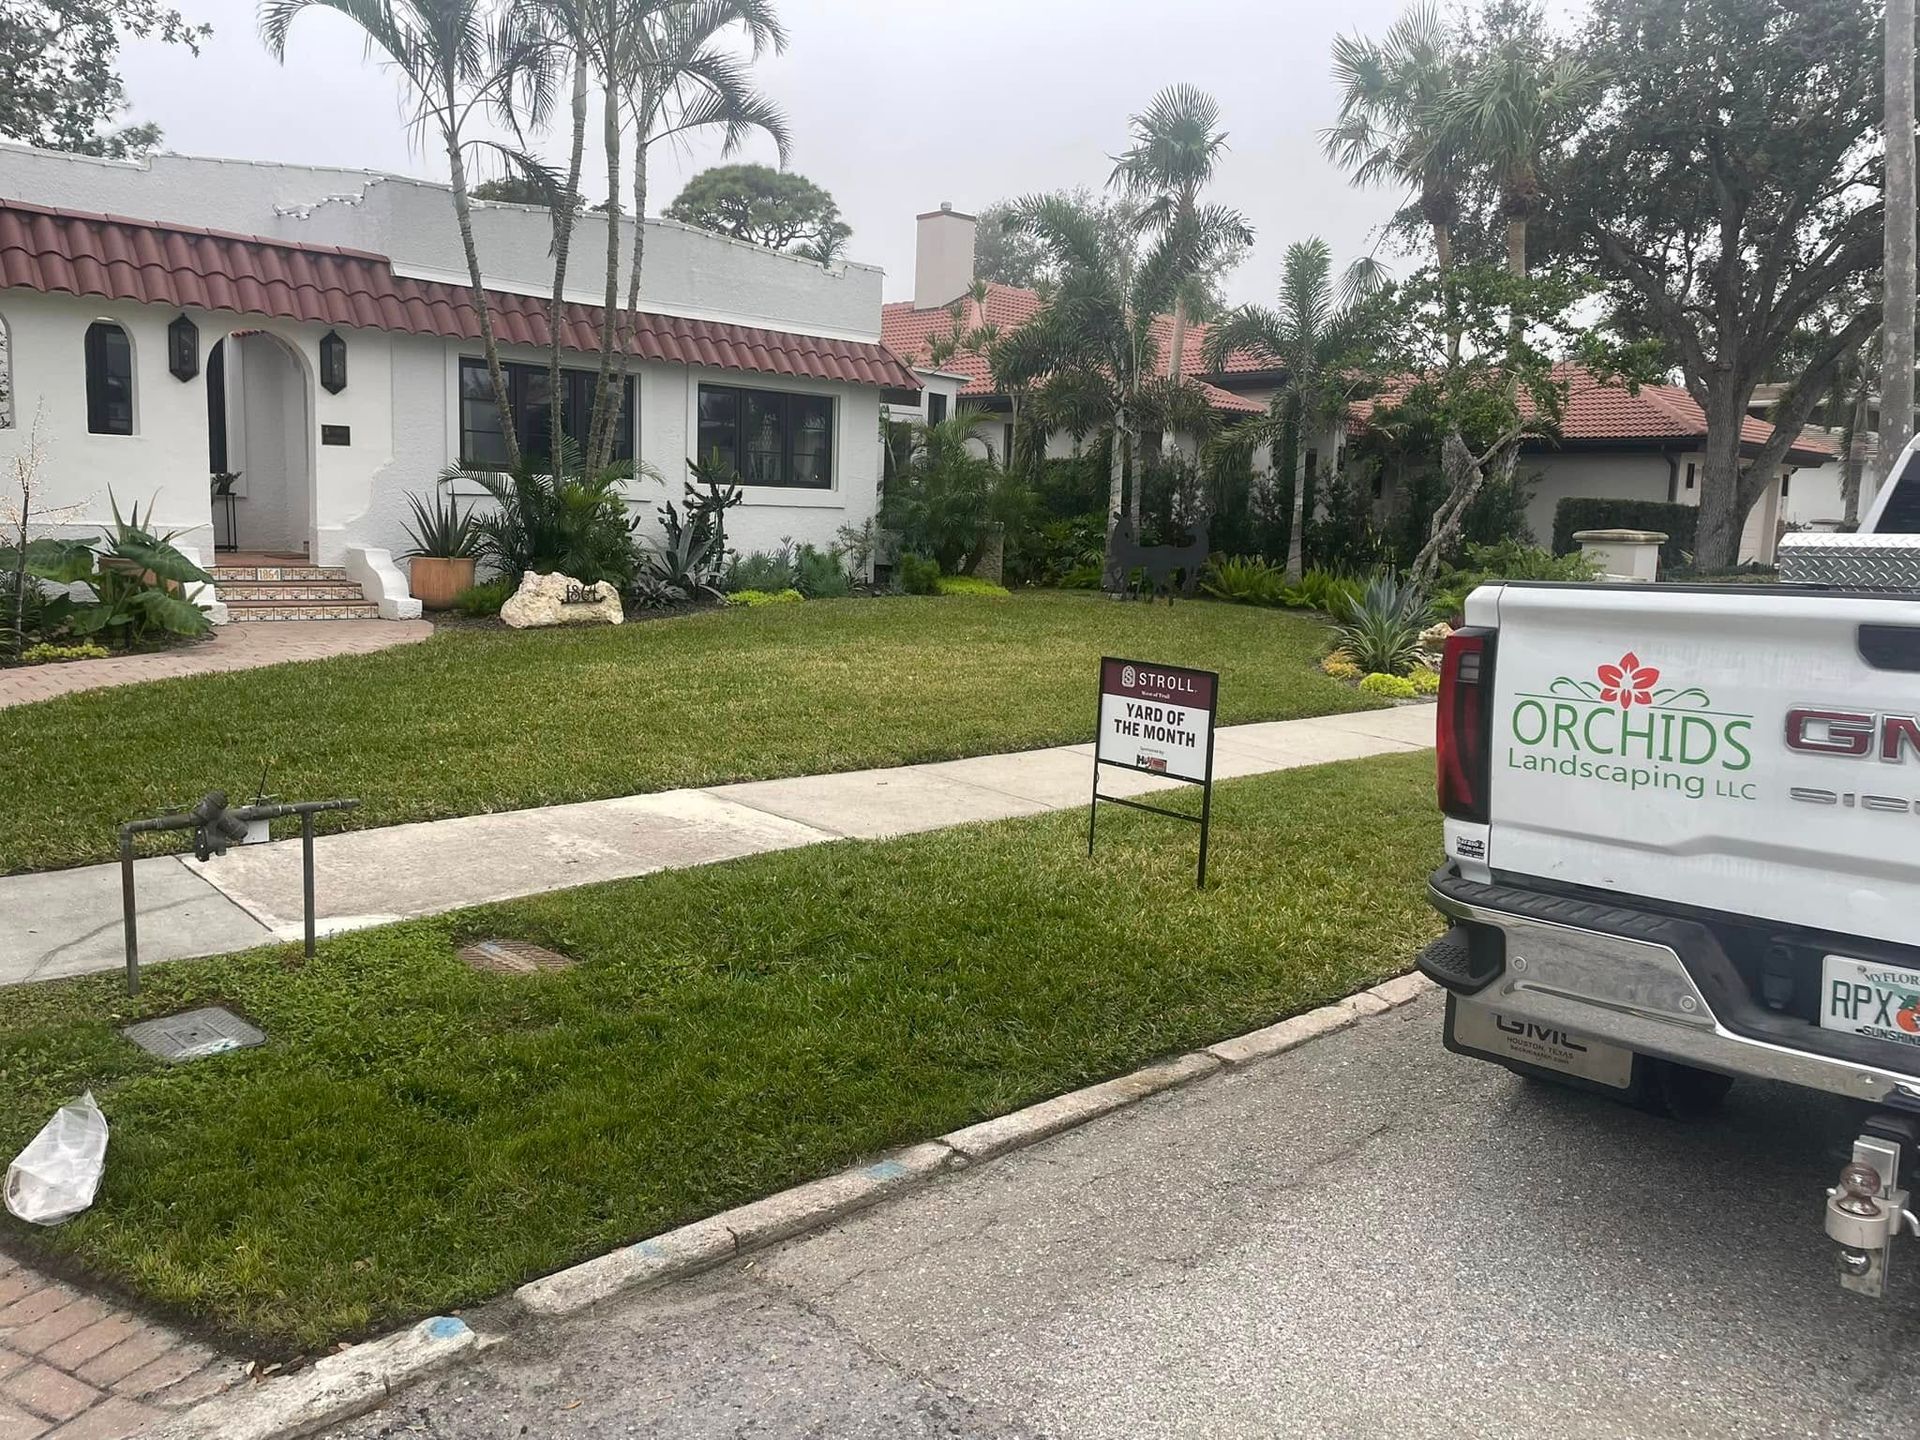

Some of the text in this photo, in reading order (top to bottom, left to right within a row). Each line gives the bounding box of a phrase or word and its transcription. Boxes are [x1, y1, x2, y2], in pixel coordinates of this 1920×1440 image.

[1138, 672, 1194, 693] STROLL
[1126, 702, 1186, 727] YARD OF
[1114, 718, 1196, 748] THE MONTH
[1511, 699, 1752, 771] ORCHIDS
[1507, 747, 1757, 801] Landscaping LLC
[1789, 786, 1920, 816] SIE
[1831, 980, 1894, 1027] RPX
